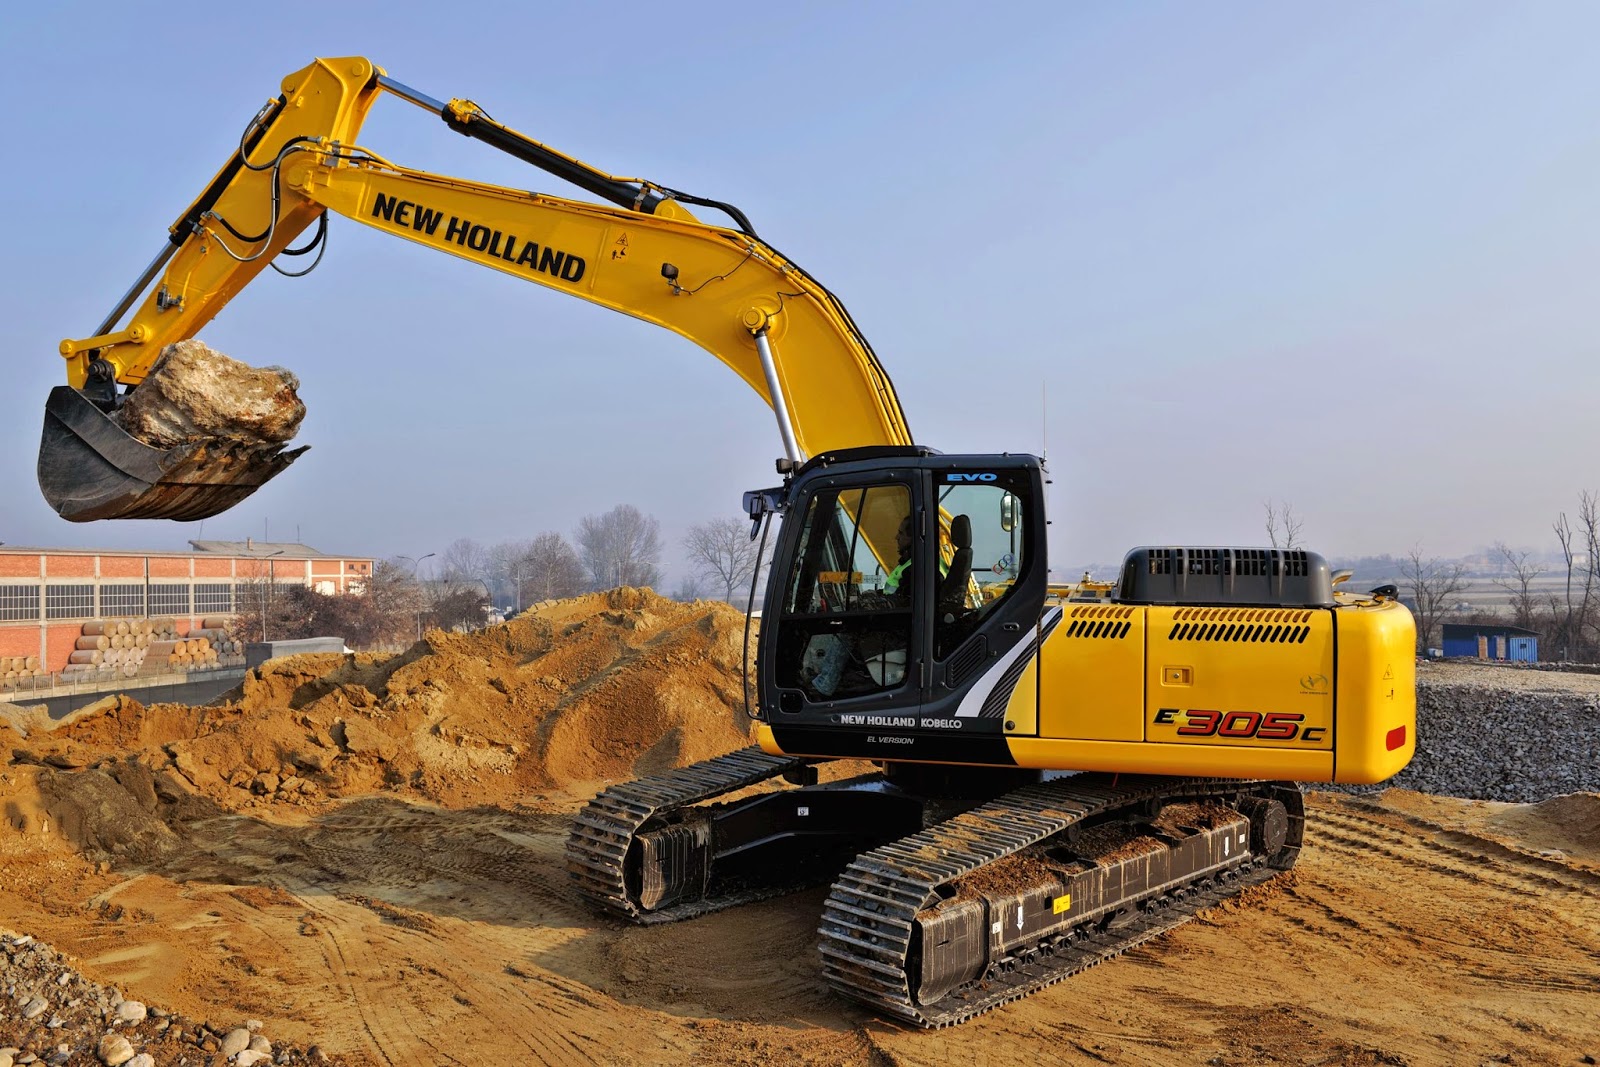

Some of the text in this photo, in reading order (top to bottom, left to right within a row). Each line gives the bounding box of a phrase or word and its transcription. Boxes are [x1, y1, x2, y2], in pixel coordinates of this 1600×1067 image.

[371, 192, 586, 283] NEW HOLLAND
[946, 473, 998, 482] EVO
[840, 714, 963, 729] NEW HOLLAND KOBELCO
[866, 735, 915, 745] EL VERSION
